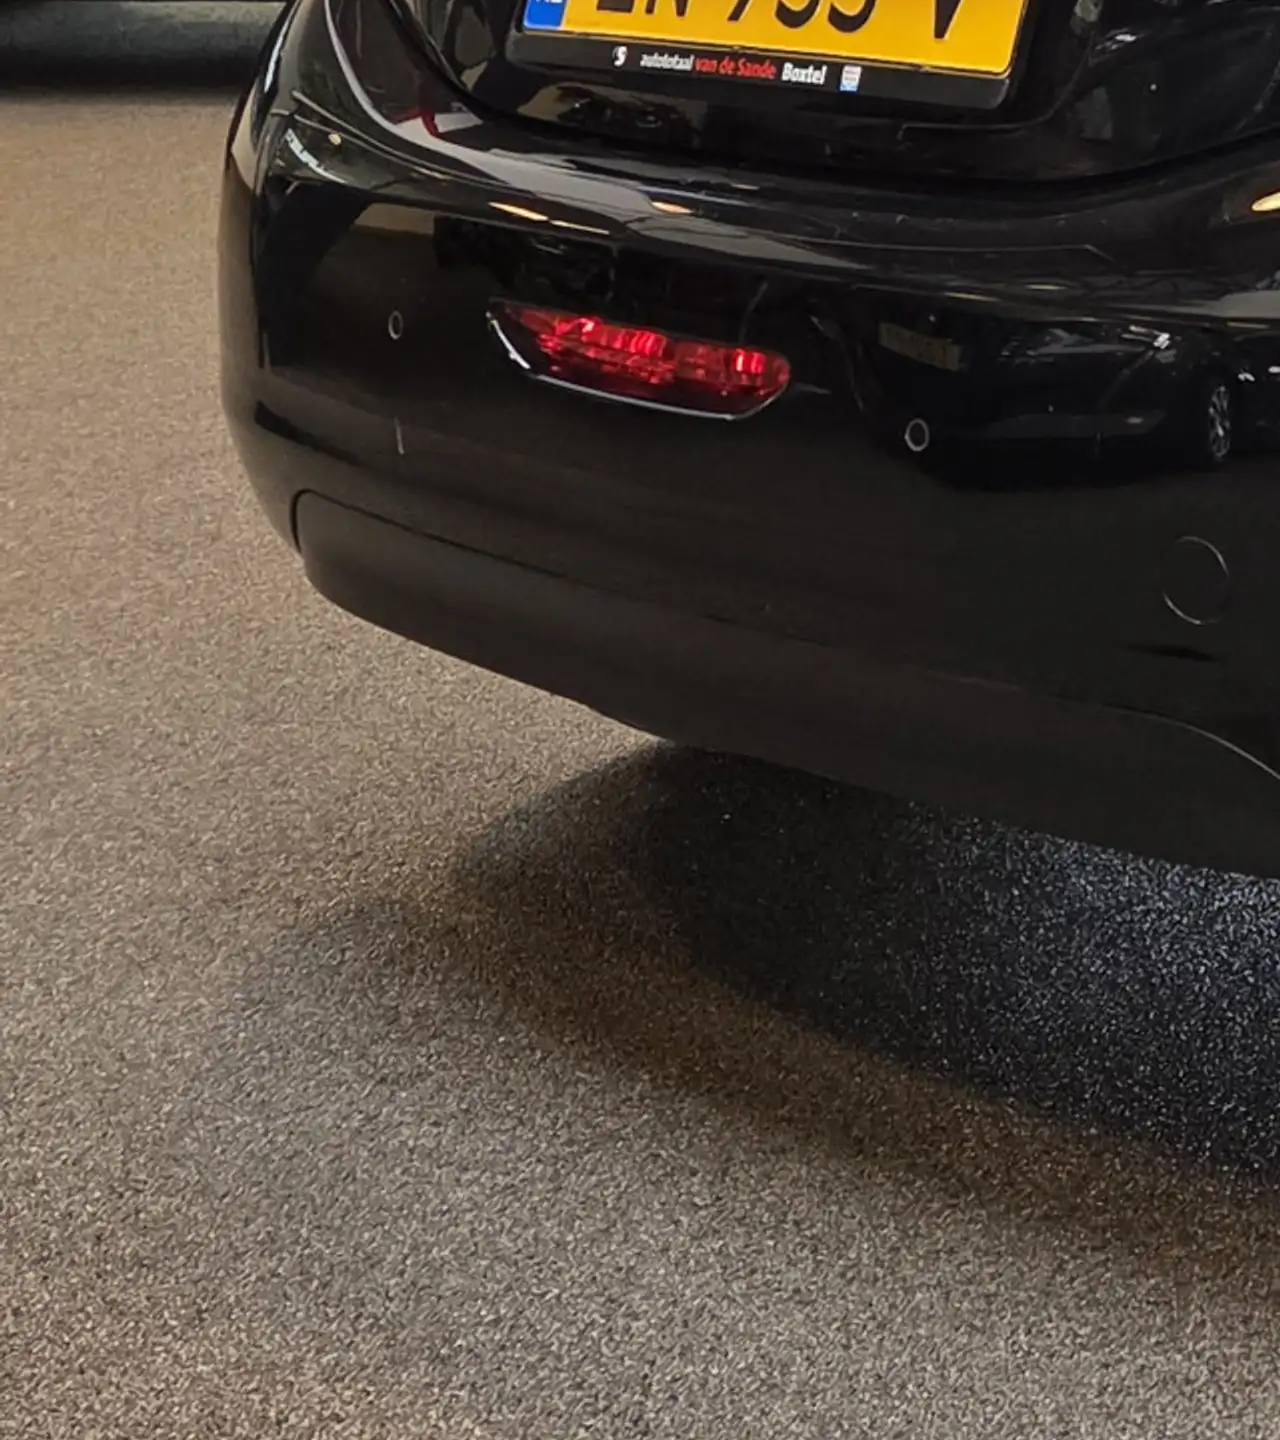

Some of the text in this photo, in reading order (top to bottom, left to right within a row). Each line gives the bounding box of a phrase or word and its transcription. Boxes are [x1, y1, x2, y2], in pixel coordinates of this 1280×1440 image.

[695, 58, 718, 73] van
[719, 56, 736, 74] de
[737, 58, 776, 79] Sande
[781, 62, 827, 84] Boxtel
